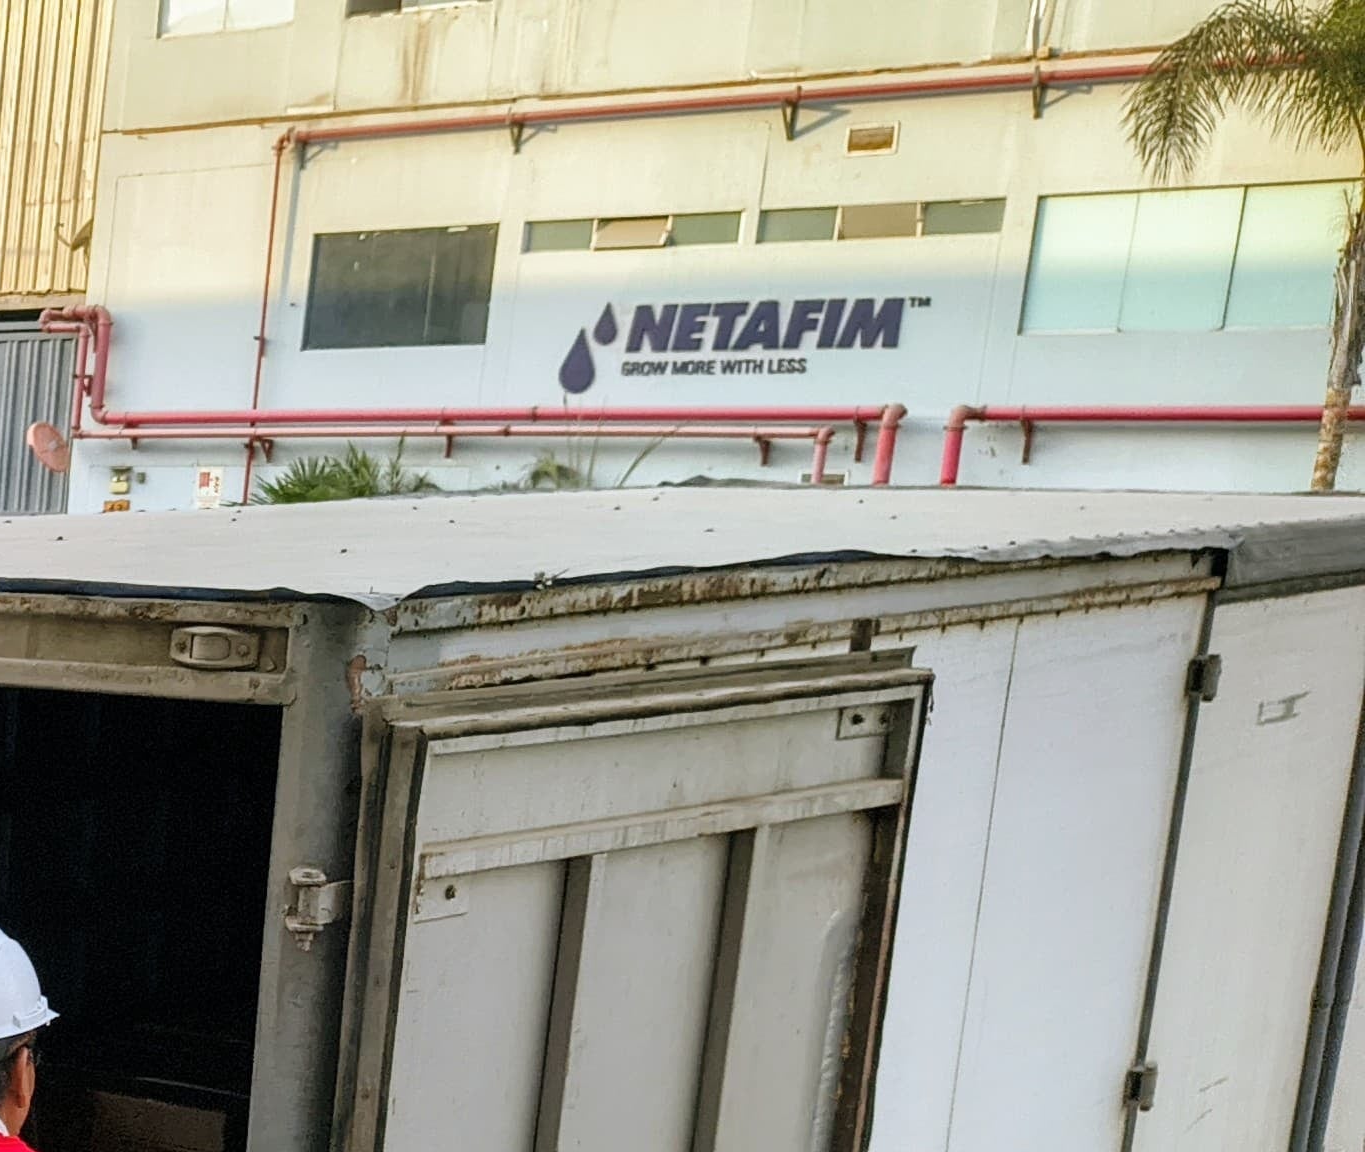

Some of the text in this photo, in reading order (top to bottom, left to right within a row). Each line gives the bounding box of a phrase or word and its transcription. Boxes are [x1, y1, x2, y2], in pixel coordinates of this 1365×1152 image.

[624, 297, 907, 353] NETAFIM
[622, 358, 808, 377] GROW MORE WITH LESS
